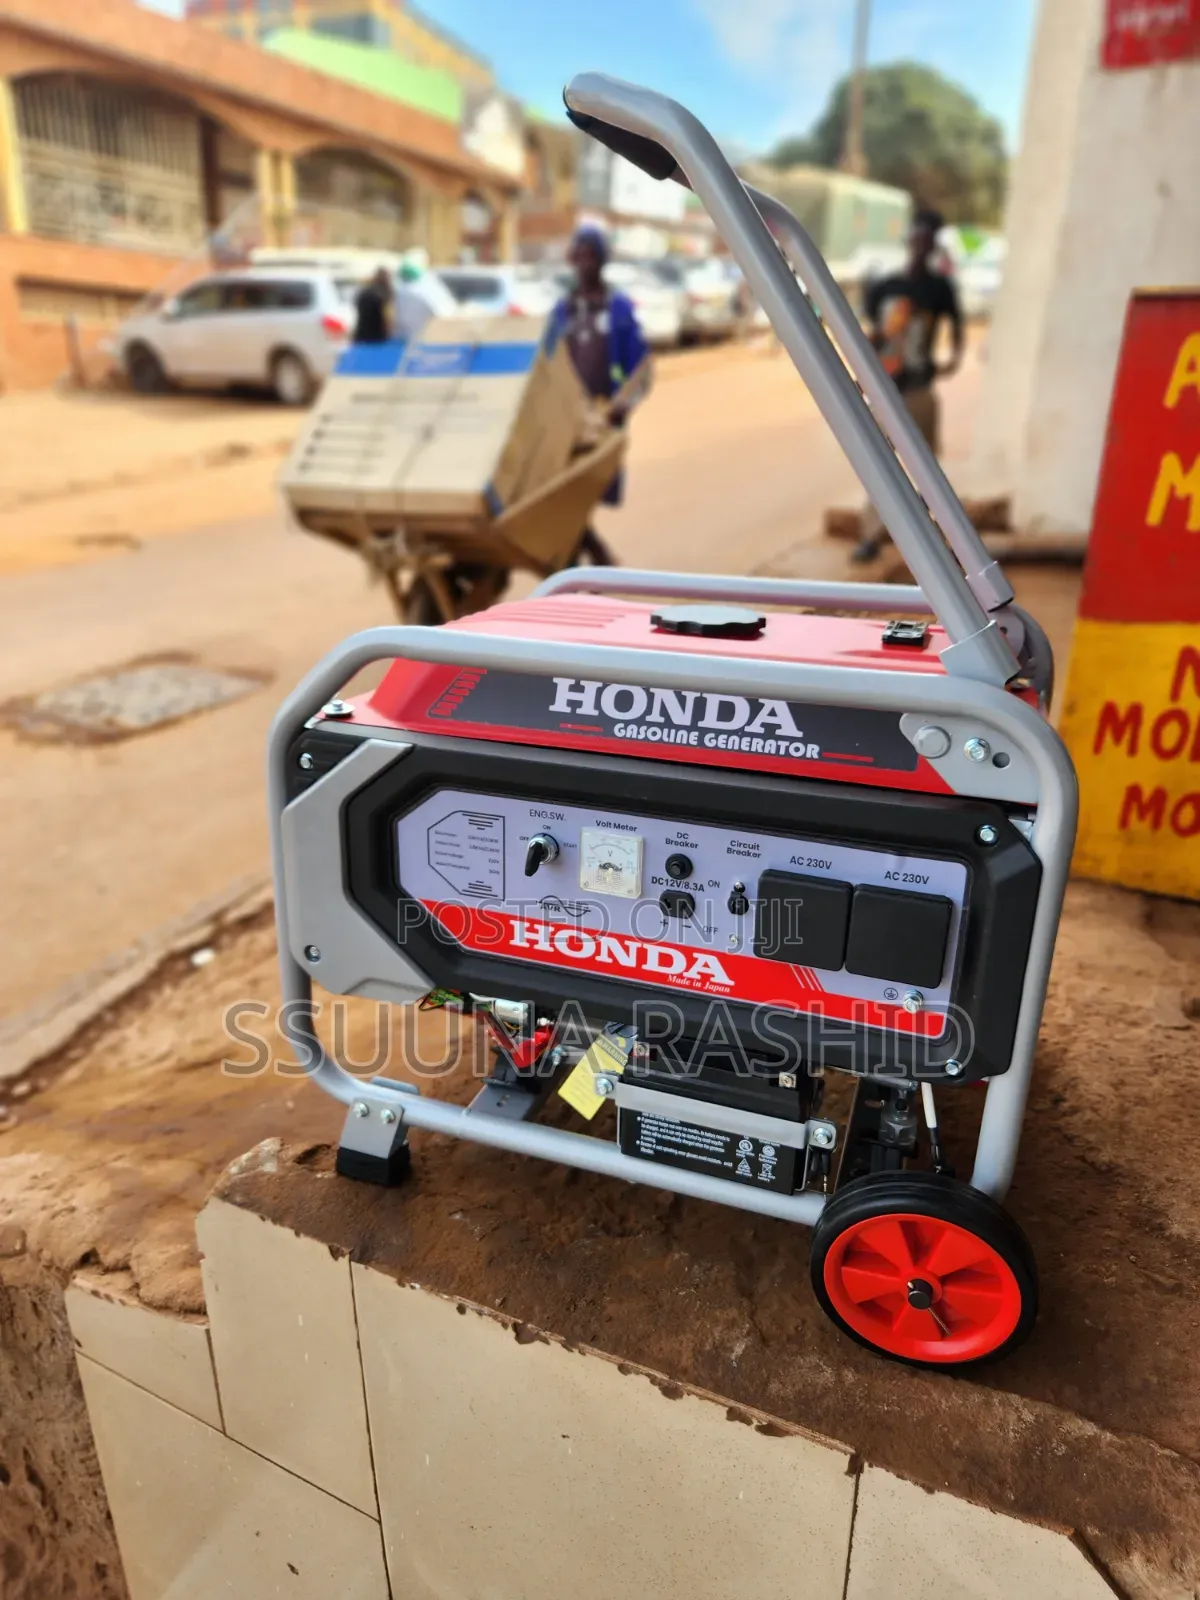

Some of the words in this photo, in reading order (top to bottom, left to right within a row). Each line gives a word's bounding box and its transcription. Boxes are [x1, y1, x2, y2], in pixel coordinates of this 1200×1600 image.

[549, 676, 804, 738] HONDA
[1093, 700, 1200, 763] MO
[613, 722, 699, 746] GASOLINE
[703, 732, 820, 759] GENERATOR
[595, 819, 612, 829] Volt
[613, 822, 638, 832] Meter
[665, 837, 699, 849] Breaker
[676, 831, 690, 840] DC
[726, 847, 762, 859] Breaker
[730, 840, 761, 851] Circuit
[789, 855, 805, 866] AC
[806, 858, 833, 870] 230V
[651, 876, 705, 893] DC12V/8.3A
[707, 879, 721, 889] ON
[884, 870, 901, 881] AC
[902, 872, 930, 885] 230V
[509, 919, 735, 986] HONDA
[667, 973, 691, 987] Made
[692, 979, 702, 988] in
[703, 981, 731, 994] Japan
